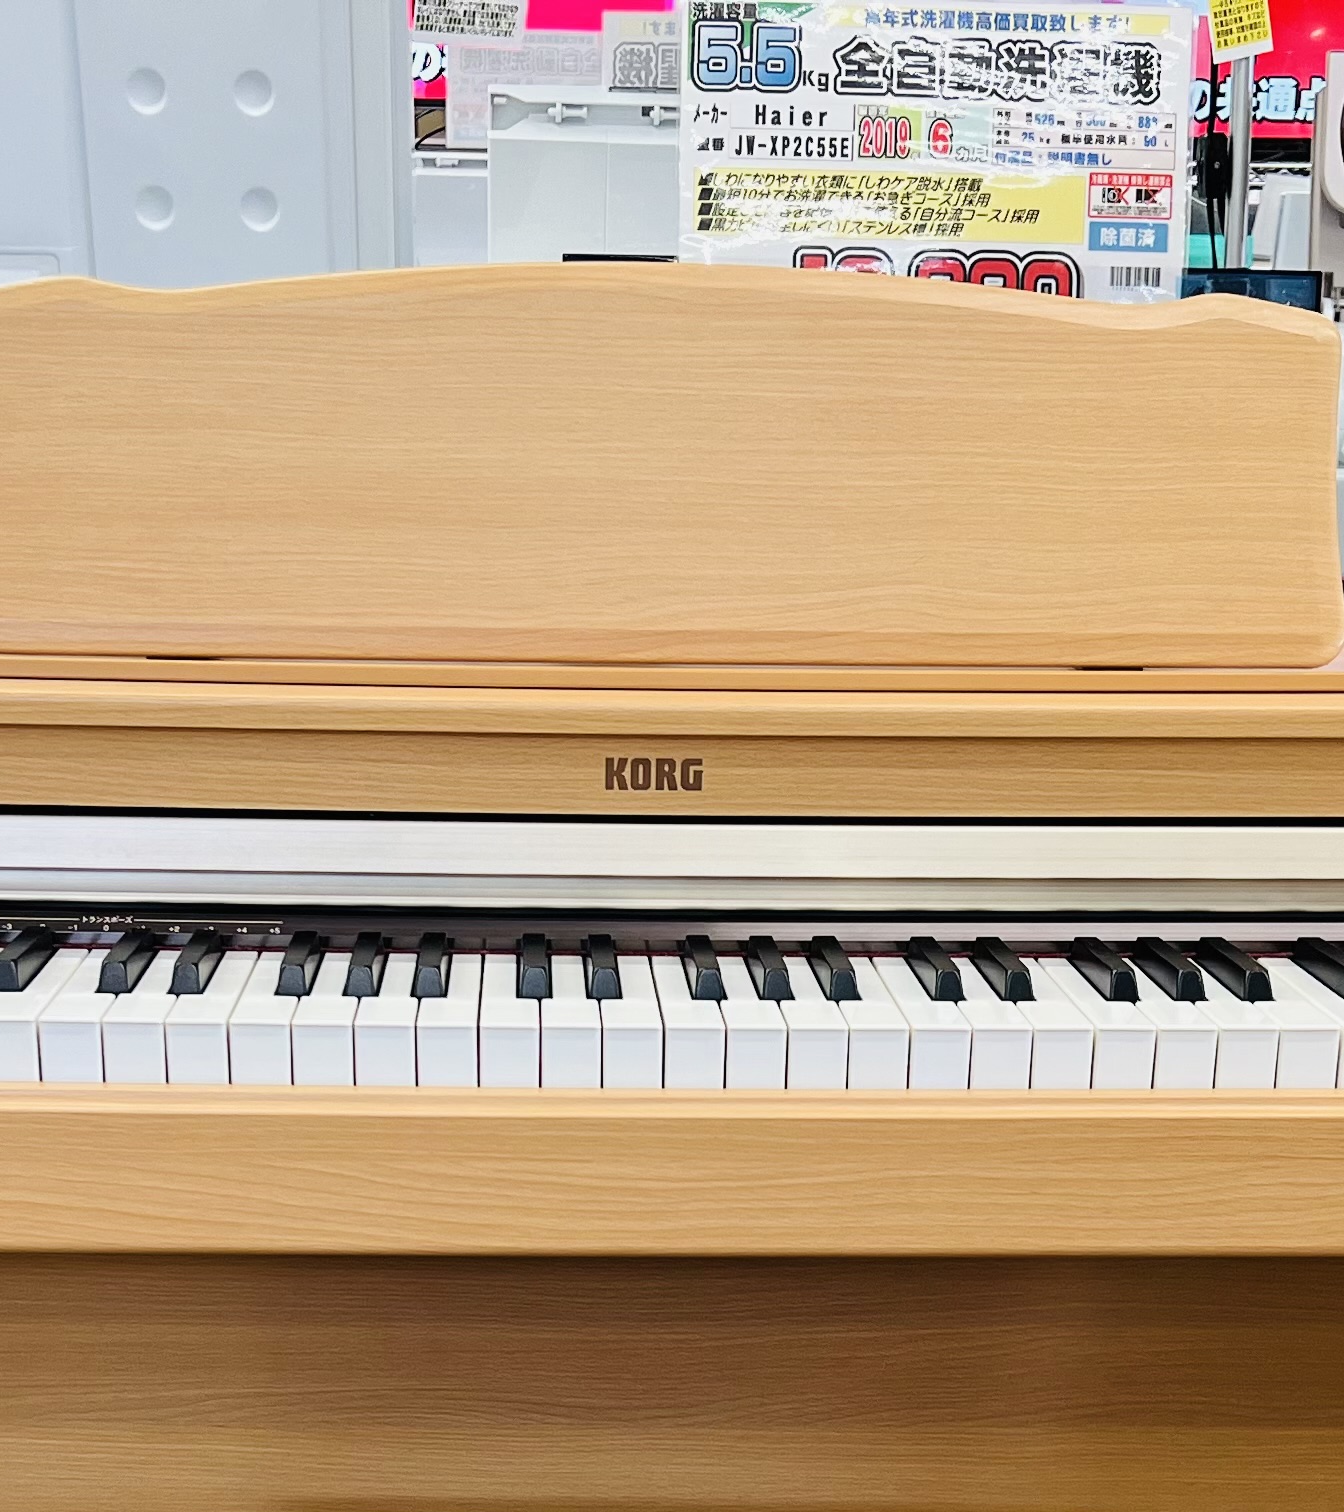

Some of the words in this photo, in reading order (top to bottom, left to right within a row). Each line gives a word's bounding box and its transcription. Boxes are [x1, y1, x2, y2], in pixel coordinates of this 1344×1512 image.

[692, 2, 757, 19] 洗濯容量
[691, 18, 802, 93] 5.5
[754, 104, 828, 127] Haier
[734, 134, 850, 158] JW-XP2C55E
[858, 116, 912, 159] 2019
[1099, 227, 1156, 248] 除菌済
[604, 757, 704, 792] KORG
